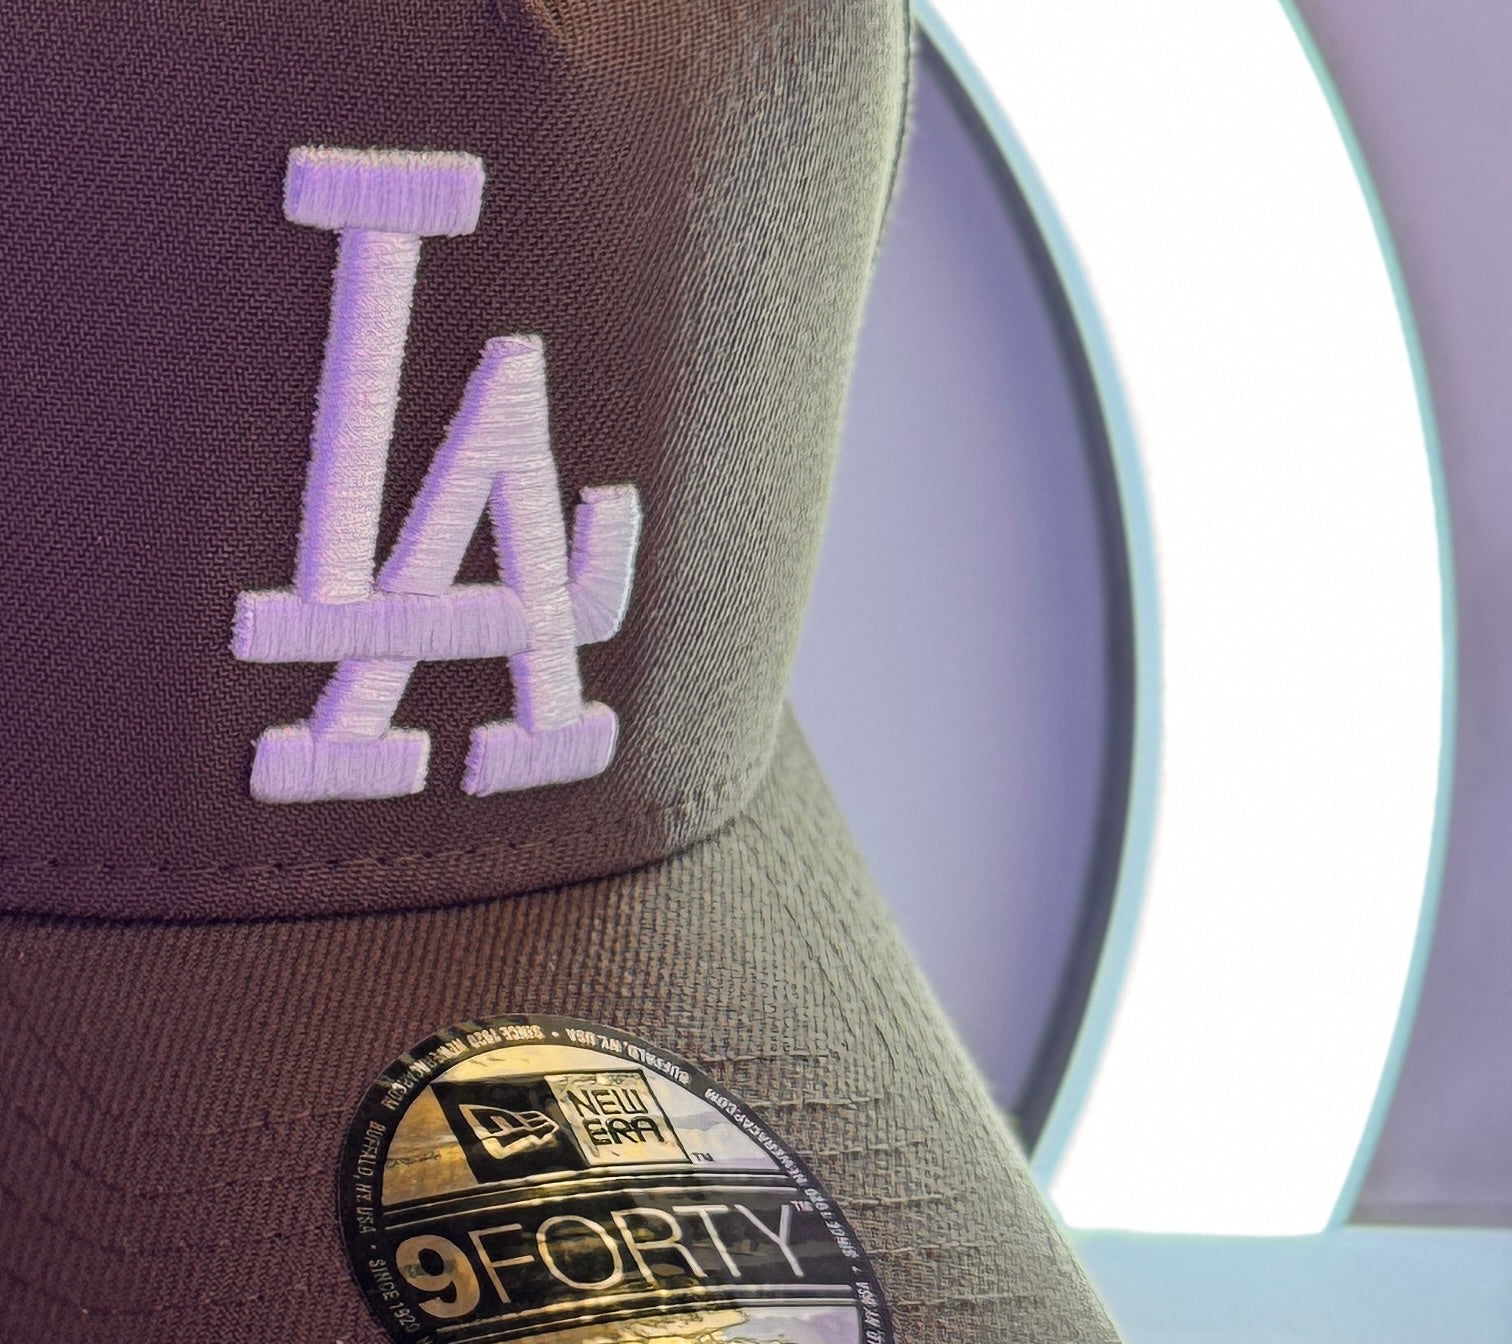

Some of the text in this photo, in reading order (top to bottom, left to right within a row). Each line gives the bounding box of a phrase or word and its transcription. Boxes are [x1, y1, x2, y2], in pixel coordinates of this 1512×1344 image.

[229, 144, 643, 803] LA
[466, 1028, 502, 1049] 1920
[499, 1024, 546, 1041] SINCE
[566, 1088, 648, 1117] NEW
[583, 1116, 665, 1145] ERA
[357, 1207, 377, 1234] USA
[368, 1258, 400, 1301] SINCE
[389, 1302, 420, 1333] 1920
[395, 1204, 805, 1319] 9FORTY
